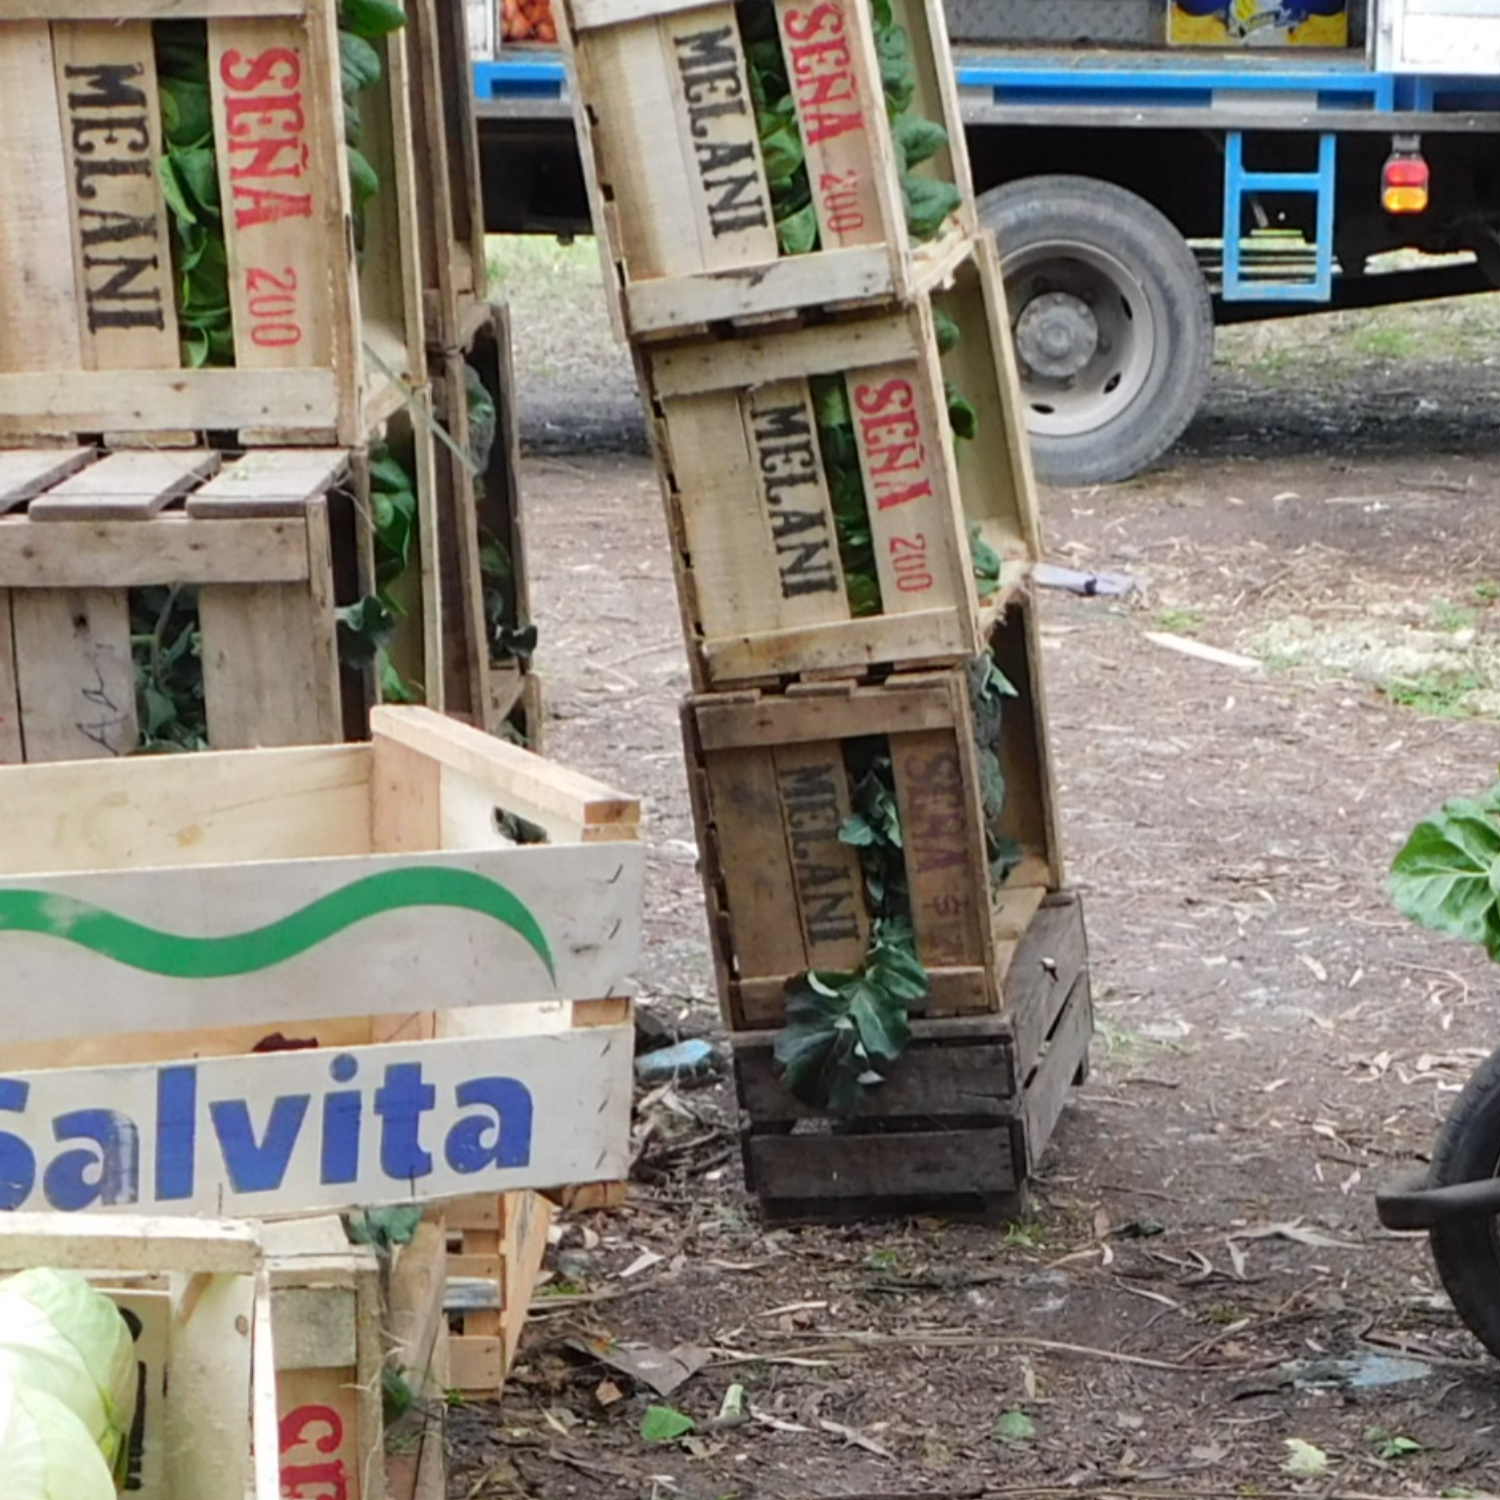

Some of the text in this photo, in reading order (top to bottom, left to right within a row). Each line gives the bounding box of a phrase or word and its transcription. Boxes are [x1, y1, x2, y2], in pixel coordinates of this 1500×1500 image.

[64, 61, 165, 335] MELANI
[219, 47, 314, 231] SEÑA
[673, 25, 768, 239] MELANI
[751, 403, 839, 599] MELANI
[854, 378, 933, 512] SEÑA
[778, 763, 860, 946] MELANI
